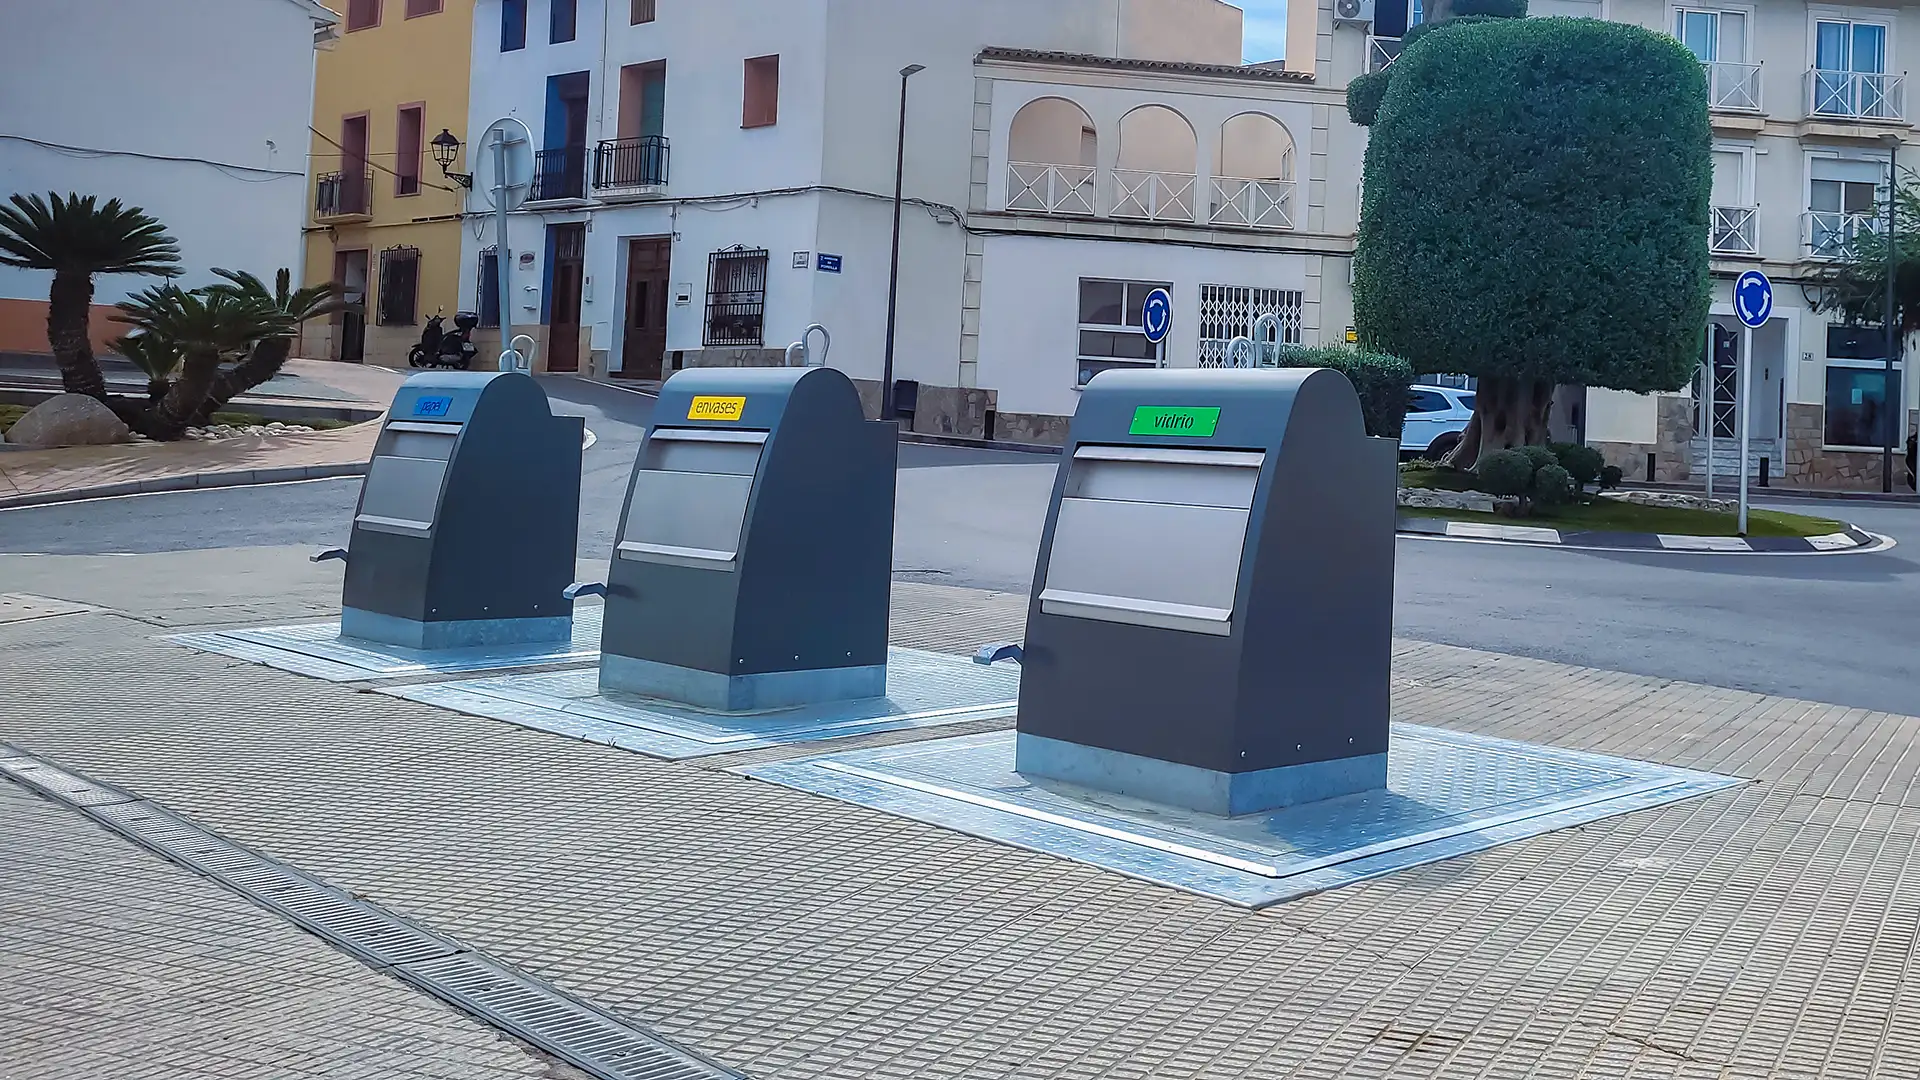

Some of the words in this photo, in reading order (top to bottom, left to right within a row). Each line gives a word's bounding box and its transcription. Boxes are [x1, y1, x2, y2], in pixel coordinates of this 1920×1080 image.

[420, 399, 443, 414] papel
[695, 401, 737, 414] envases
[1155, 413, 1194, 429] vidrio
